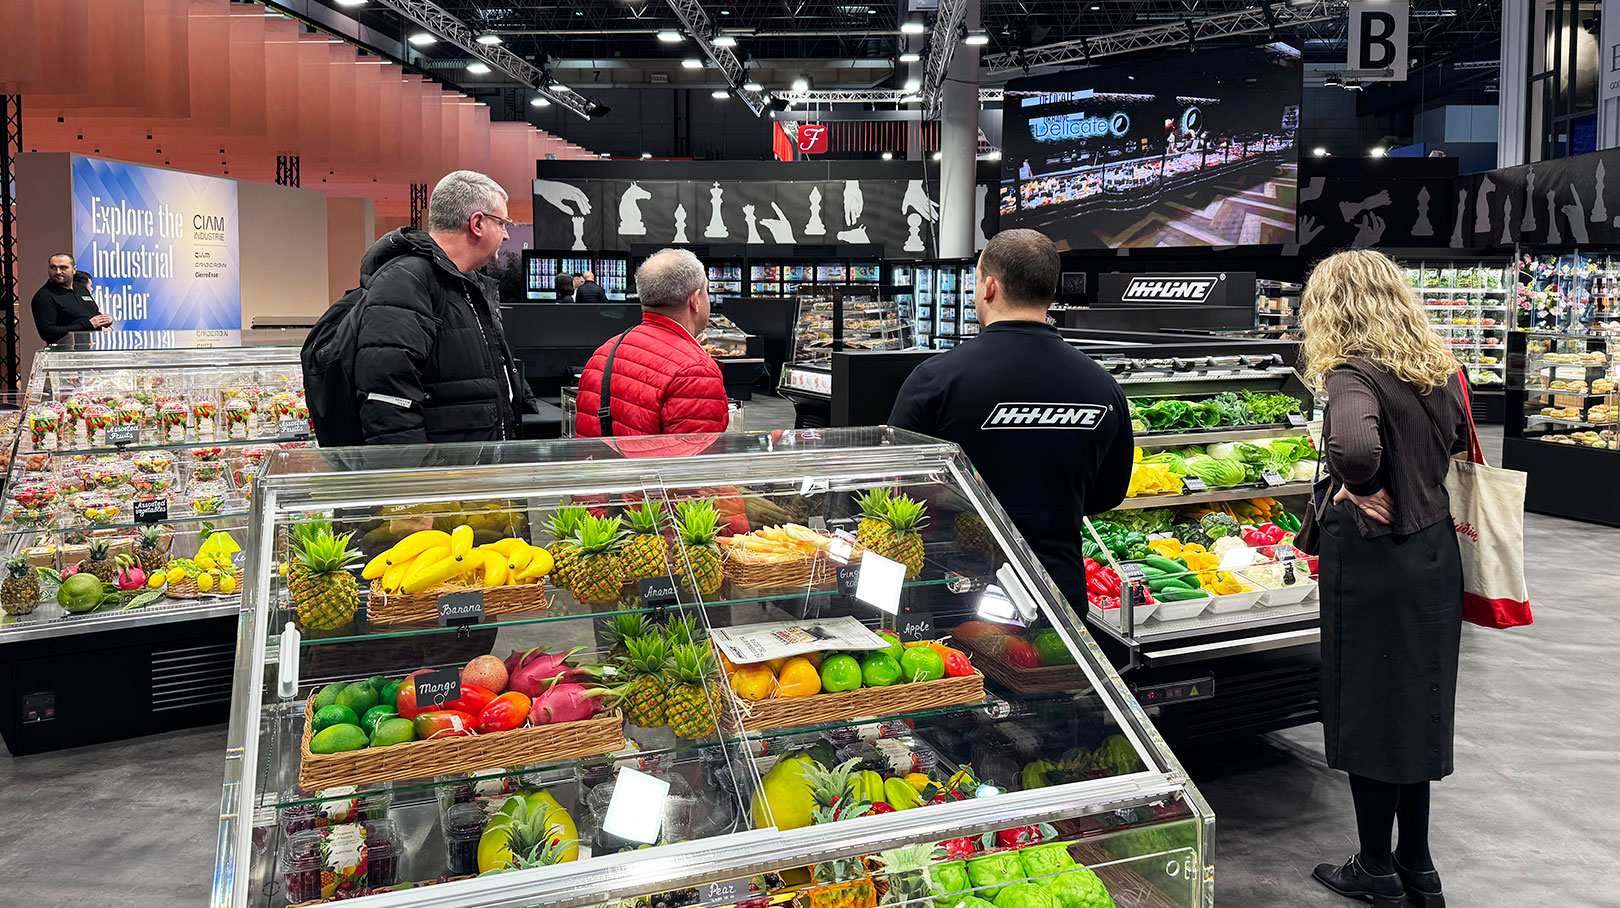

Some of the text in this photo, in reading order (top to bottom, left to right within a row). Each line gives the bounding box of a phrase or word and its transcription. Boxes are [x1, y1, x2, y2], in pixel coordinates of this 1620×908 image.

[1360, 11, 1397, 69] B
[592, 70, 601, 82] 7
[1034, 119, 1109, 139] Delicate
[91, 196, 183, 244] Explore the
[192, 214, 225, 232] CIAM
[193, 231, 225, 242] INDUSTRIE
[92, 241, 174, 279] Industrial
[93, 284, 150, 321] Atelier
[440, 603, 483, 616] Banana
[903, 621, 930, 636] Apple
[418, 681, 457, 697] Mango
[708, 882, 737, 898] Pear
